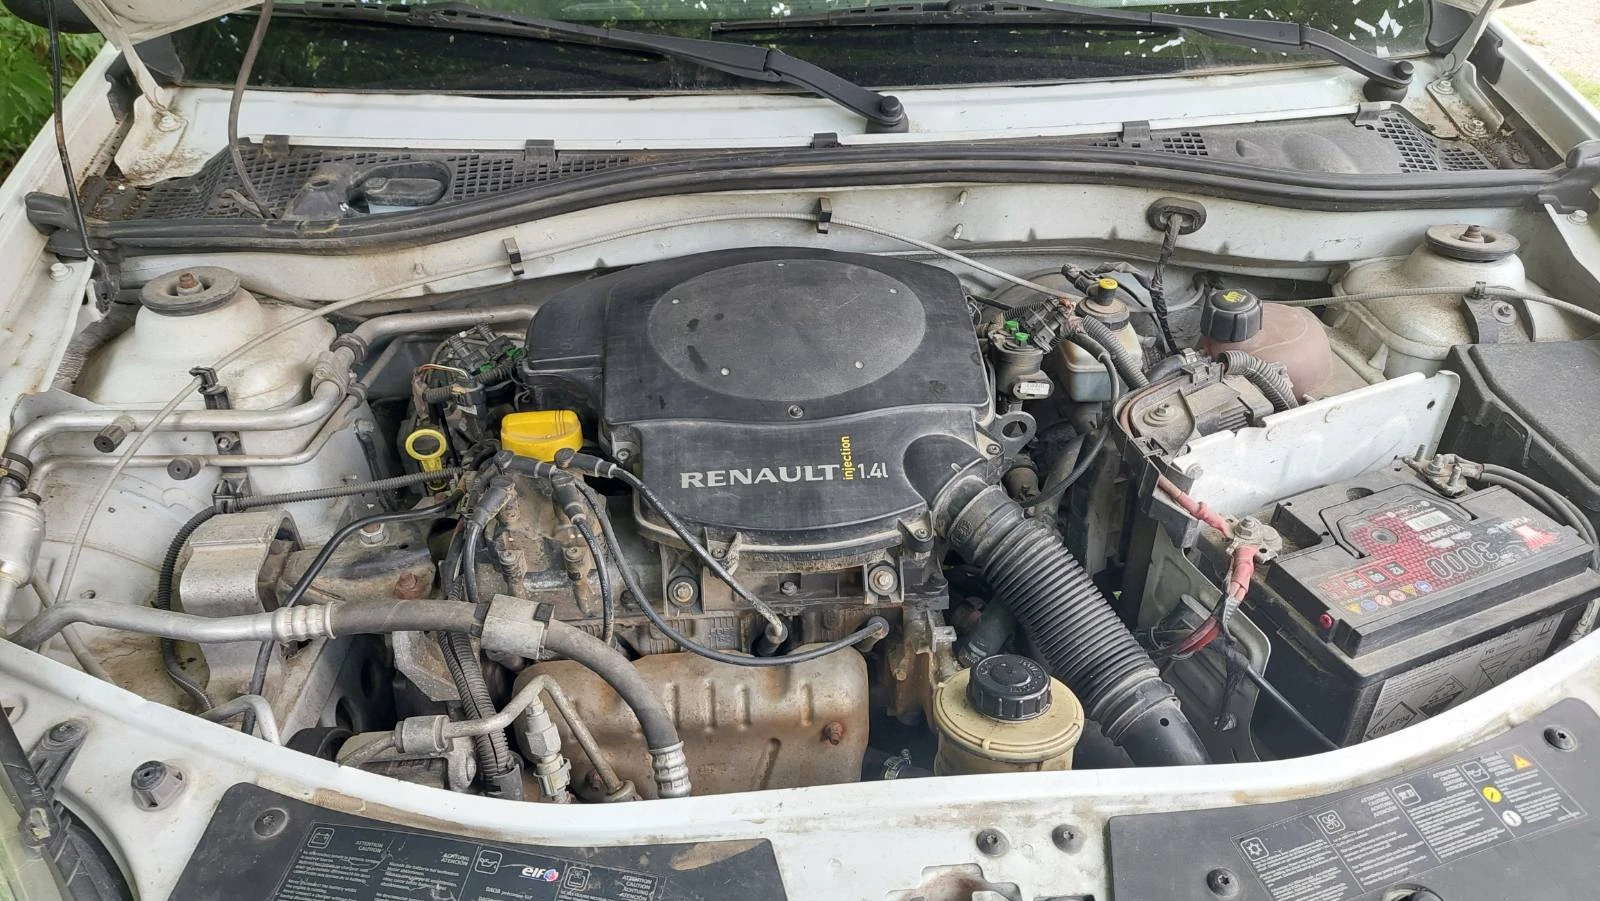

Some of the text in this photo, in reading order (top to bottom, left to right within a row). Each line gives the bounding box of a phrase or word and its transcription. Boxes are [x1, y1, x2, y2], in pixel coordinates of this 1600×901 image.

[840, 435, 855, 480] injection
[680, 464, 840, 488] RENAULT
[1426, 541, 1500, 580] 3000
[522, 867, 547, 879] elf
